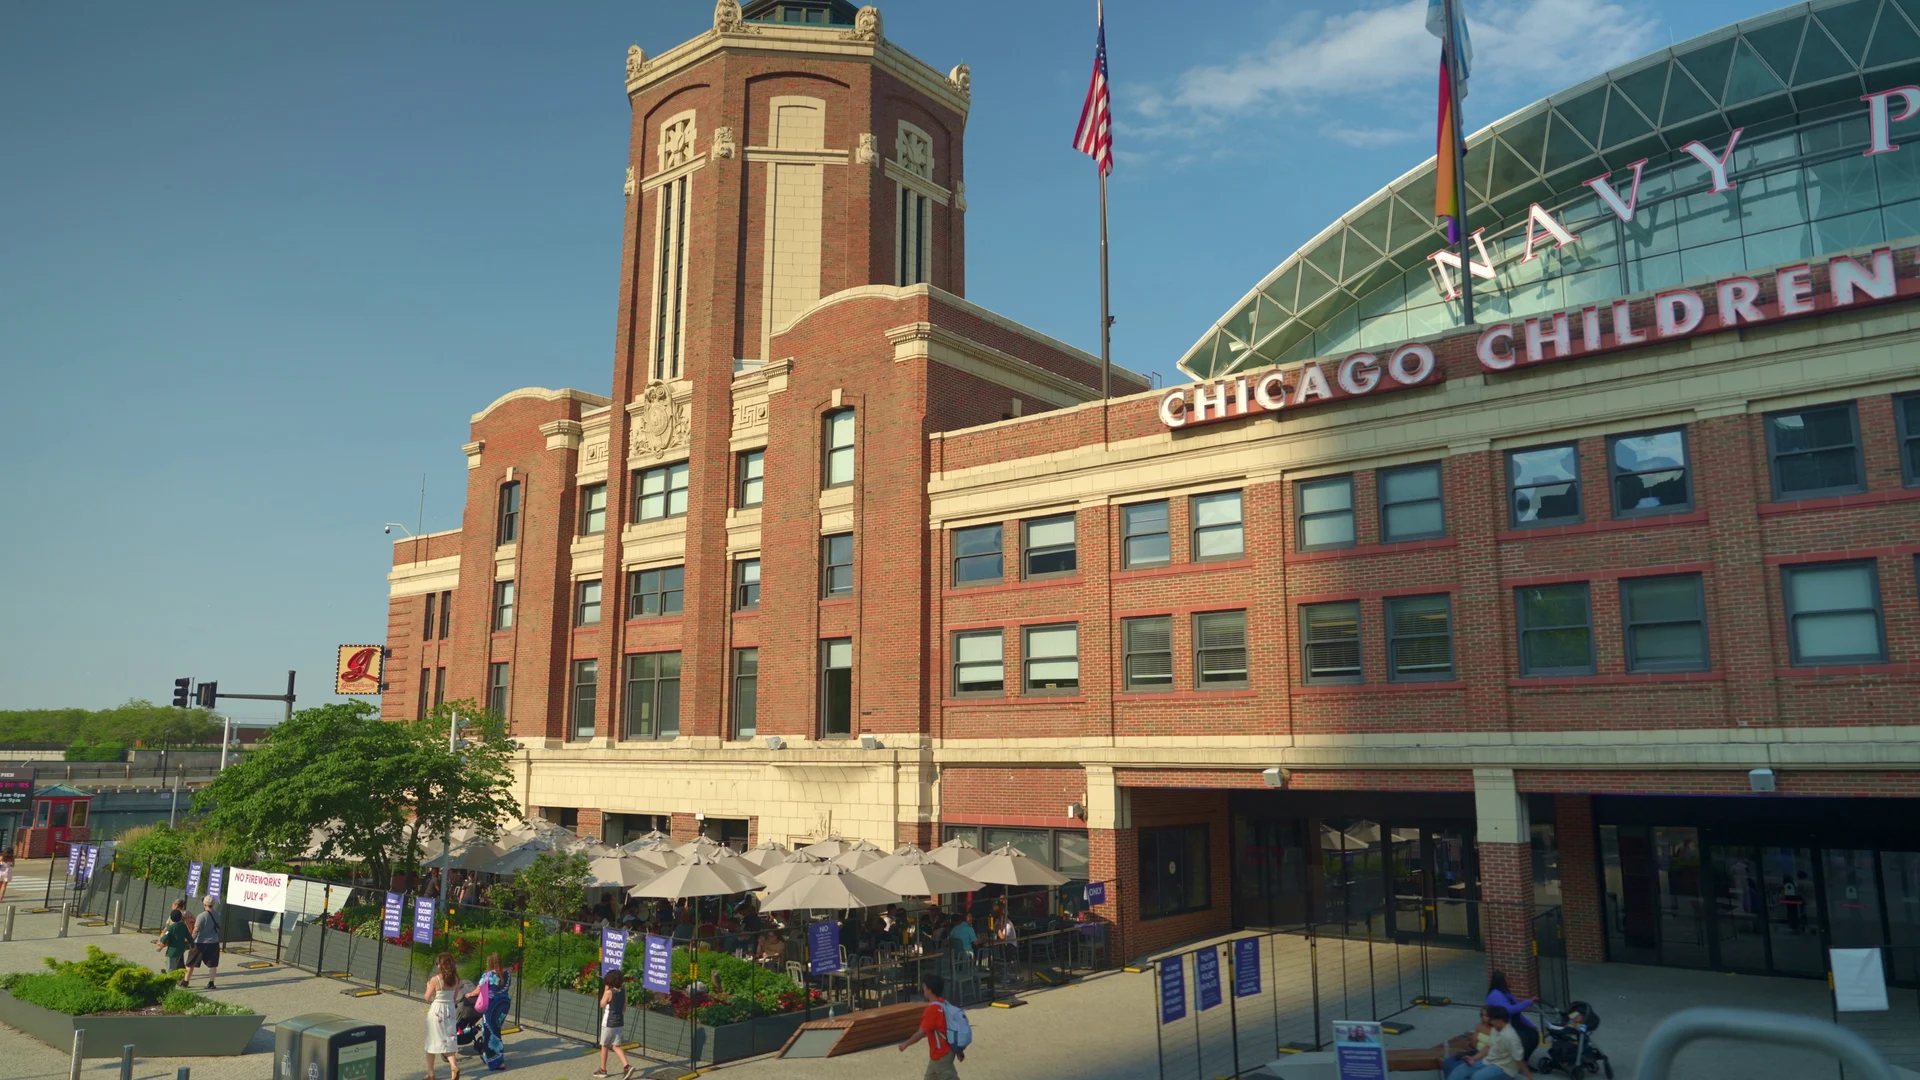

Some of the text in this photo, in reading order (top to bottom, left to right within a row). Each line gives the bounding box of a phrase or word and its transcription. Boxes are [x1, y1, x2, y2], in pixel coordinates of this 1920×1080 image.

[1426, 127, 1744, 303] NAVY
[1158, 342, 1436, 430] CHICAGO
[234, 872, 245, 883] NO
[245, 874, 281, 888] FIREWORKS
[1089, 886, 1103, 896] ONLY
[243, 890, 259, 902] JULY
[421, 922, 430, 930] PLAC
[819, 925, 829, 933] NO
[607, 932, 623, 940] YOUTH
[606, 940, 624, 949] ESCORT
[1244, 942, 1254, 950] NO
[606, 949, 623, 957] POLICY
[610, 957, 622, 966] PLAC
